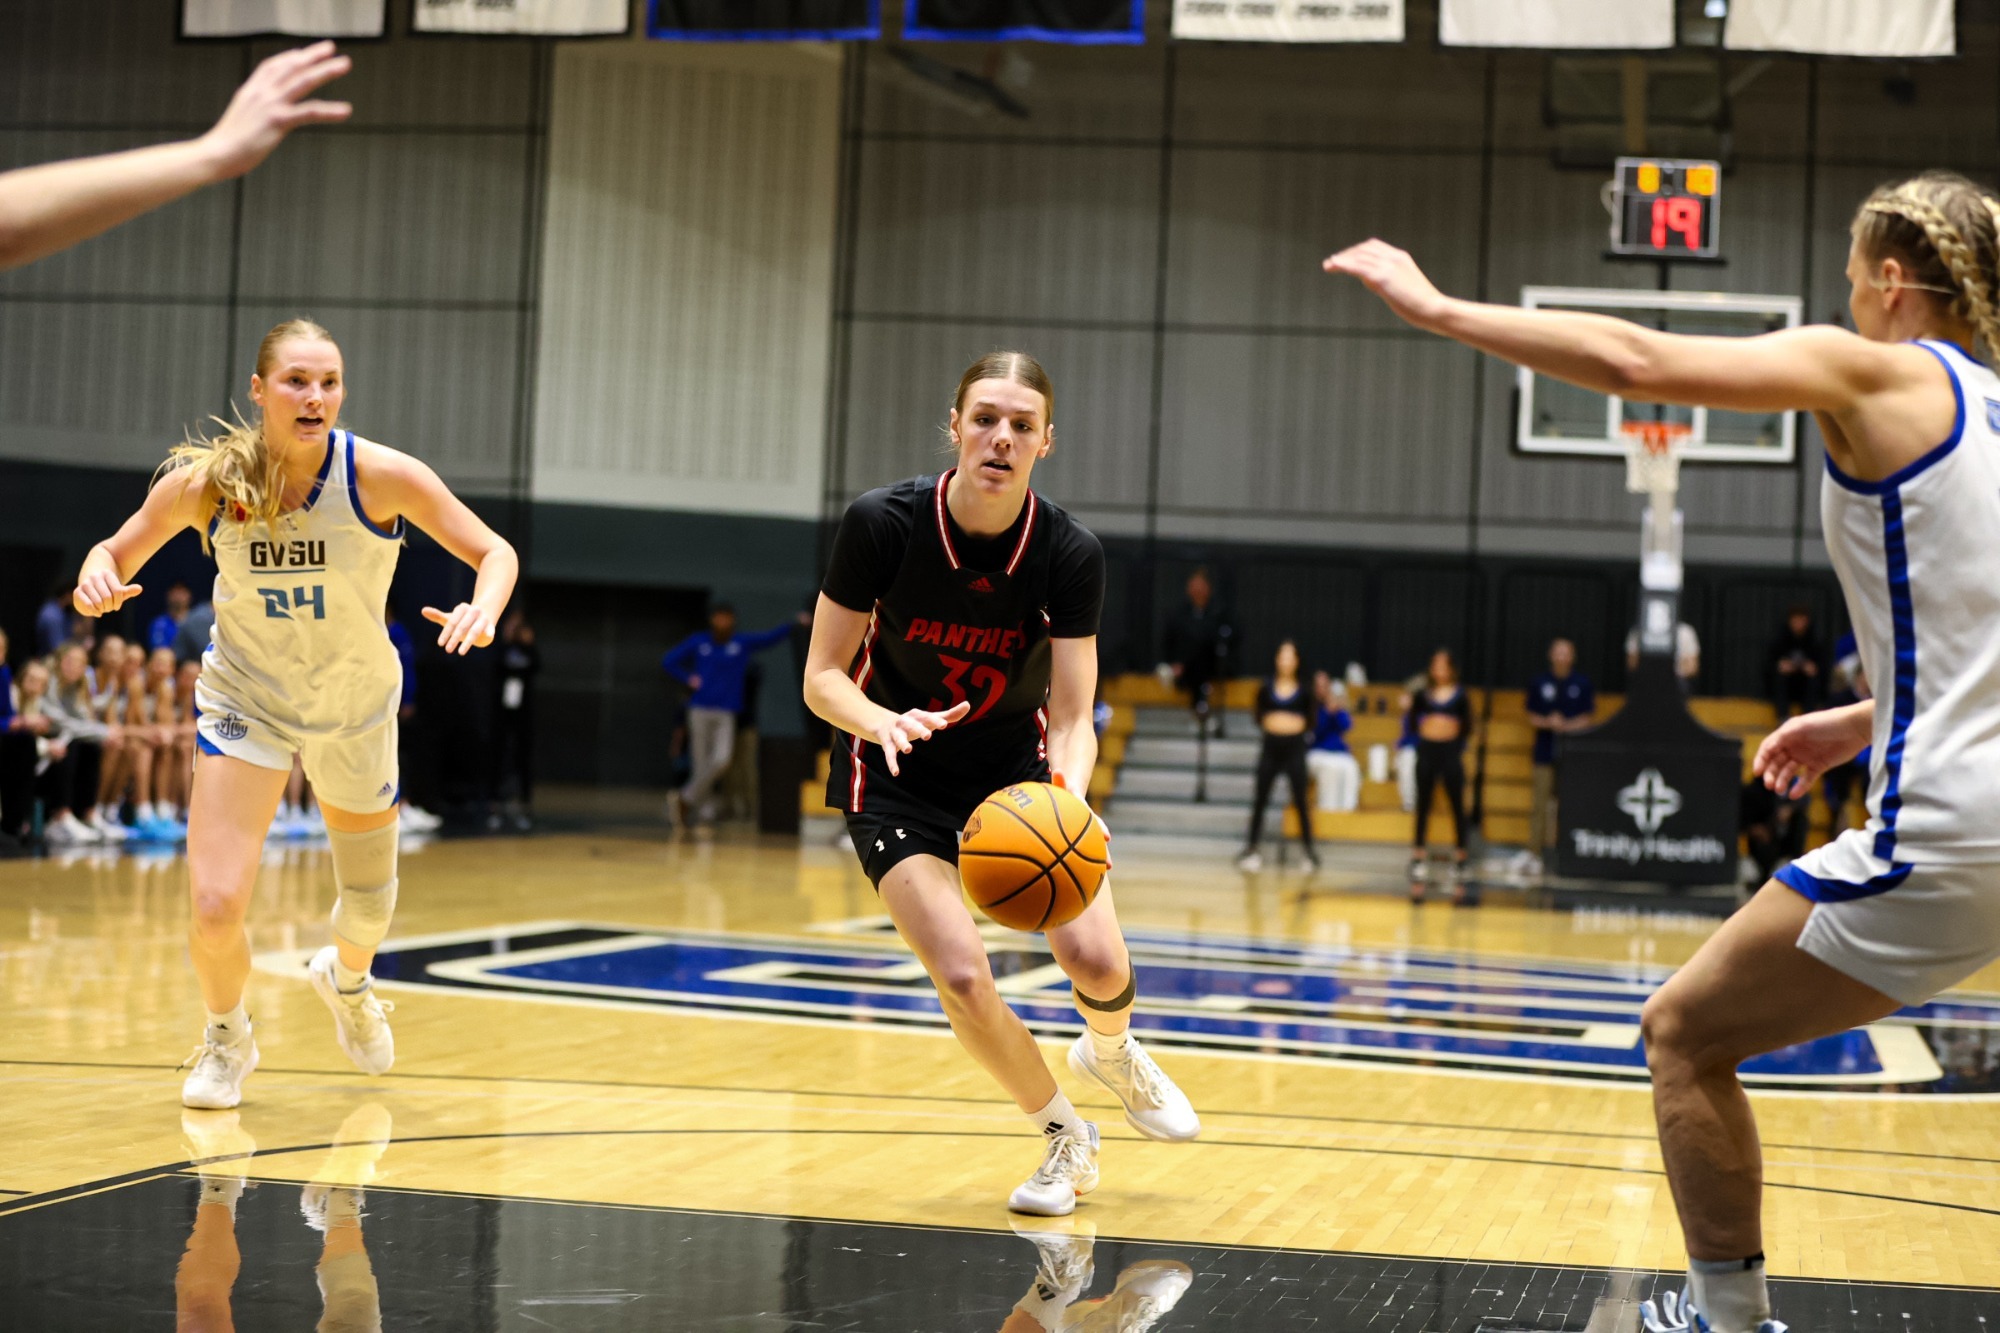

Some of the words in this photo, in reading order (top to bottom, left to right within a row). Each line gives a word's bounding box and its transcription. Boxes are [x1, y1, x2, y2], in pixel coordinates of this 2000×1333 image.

[1651, 196, 1702, 251] 19
[250, 540, 326, 567] GVSU
[257, 585, 326, 621] 24
[927, 653, 1007, 728] 32
[1571, 828, 1642, 866] Trinity
[1643, 833, 1726, 864] Health
